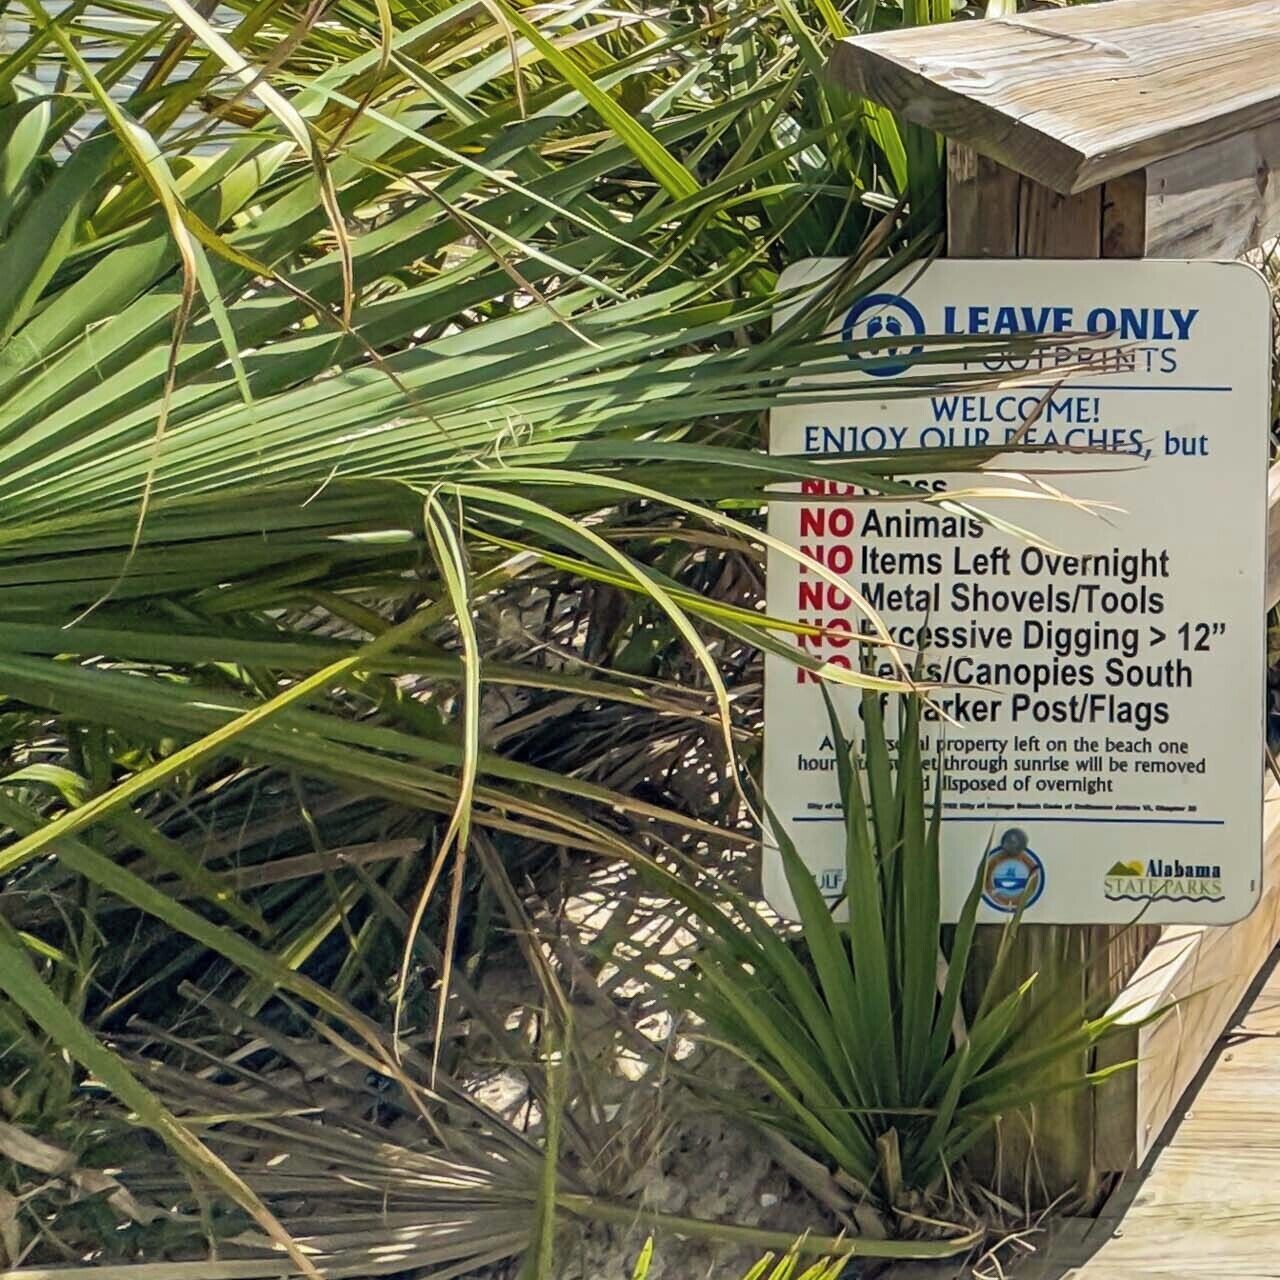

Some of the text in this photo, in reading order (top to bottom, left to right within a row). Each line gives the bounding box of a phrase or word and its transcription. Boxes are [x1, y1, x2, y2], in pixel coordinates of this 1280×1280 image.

[944, 306, 1199, 340] LEAVE ONLY
[962, 347, 1177, 373] OOTPRINTS
[931, 396, 1100, 423] WELCOME!
[805, 426, 1209, 461] ENJOY OUR BEACHES, but
[800, 508, 984, 538] NO Animals
[800, 545, 1169, 584] NO Items Left Overnight
[798, 582, 1164, 614] NO Metal Shovels/Tools
[797, 618, 852, 648] NO
[860, 619, 1012, 649] Excessive
[1024, 620, 1139, 657] Digging
[1150, 626, 1166, 646] >
[1105, 658, 1192, 687] South
[914, 693, 1001, 722] arker
[1012, 693, 1169, 731] Post/Flags
[819, 736, 854, 752] Ay
[936, 738, 1008, 754] property
[1014, 736, 1040, 751] left
[1046, 740, 1067, 752] on
[1074, 737, 1099, 752] the
[1105, 737, 1152, 753] beach
[1158, 741, 1188, 753] one
[798, 754, 836, 770] hour
[944, 755, 1008, 773] through
[1014, 756, 1069, 771] sunrise
[1075, 756, 1102, 771] will
[1109, 757, 1128, 772] be
[1135, 758, 1206, 773] removed
[1013, 776, 1031, 791] of
[1036, 777, 1113, 794] overnight
[1146, 859, 1220, 878] Alabama
[1104, 878, 1222, 895] STATE PARKS
